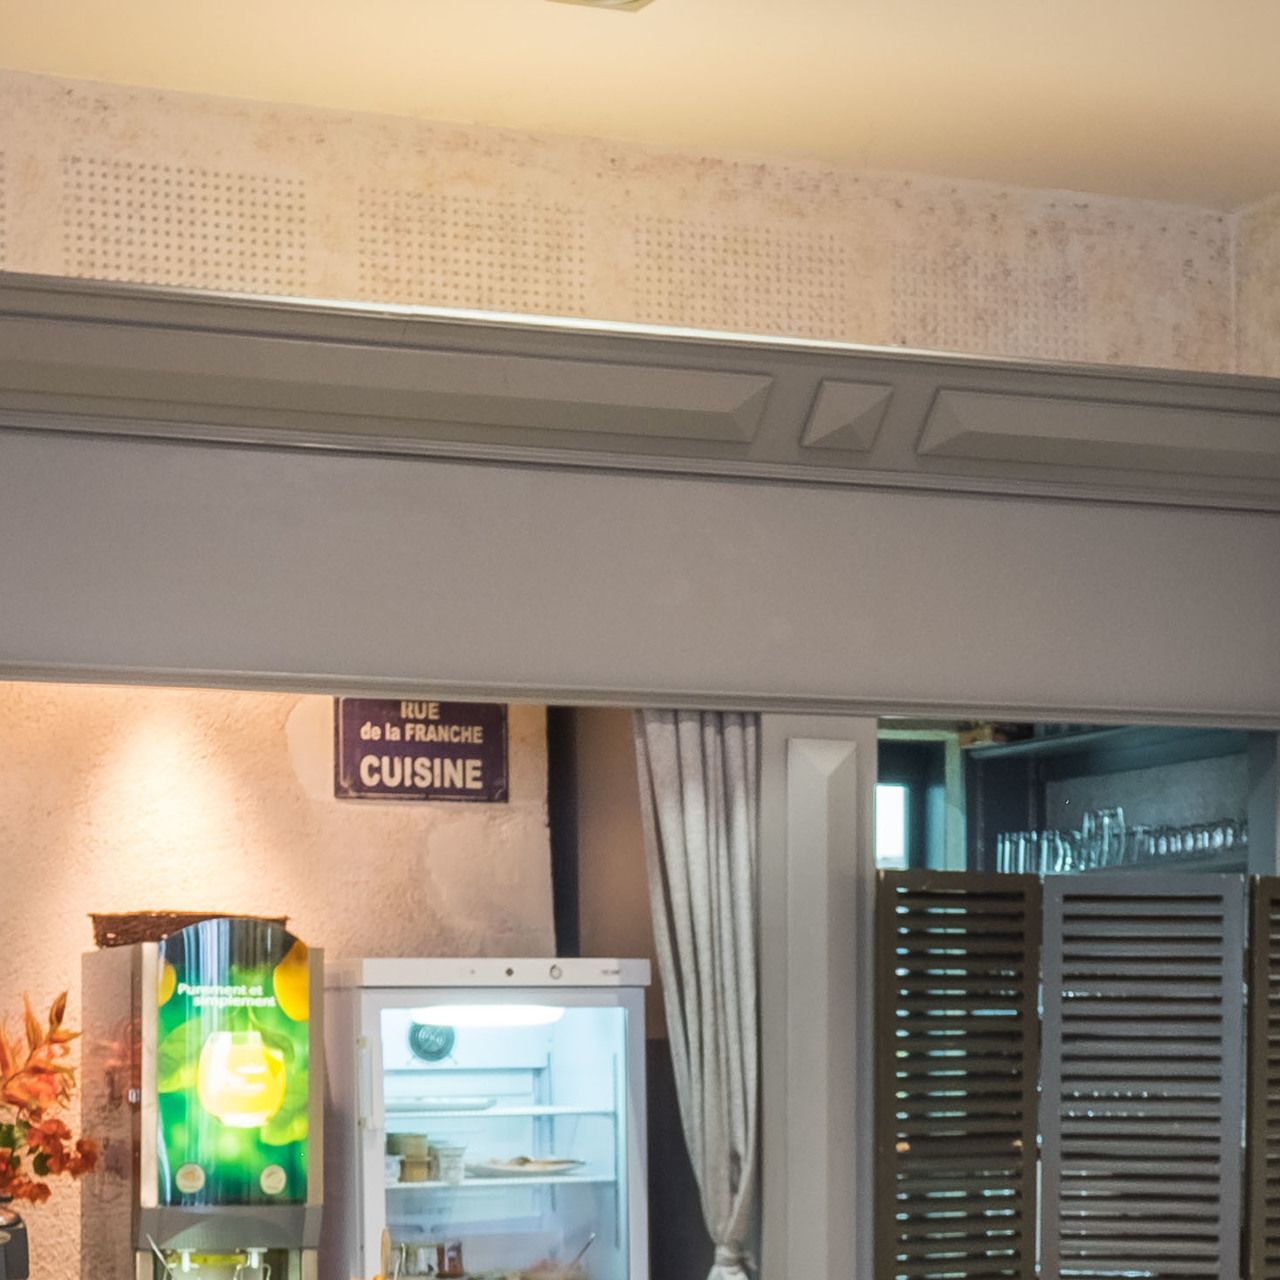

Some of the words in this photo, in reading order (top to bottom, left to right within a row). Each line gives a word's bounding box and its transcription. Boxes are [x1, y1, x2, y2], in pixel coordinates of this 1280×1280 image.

[400, 701, 440, 719] RUE
[360, 720, 382, 741] de
[385, 721, 401, 741] la
[405, 722, 483, 744] FRANCHE
[359, 754, 483, 790] CUISINE
